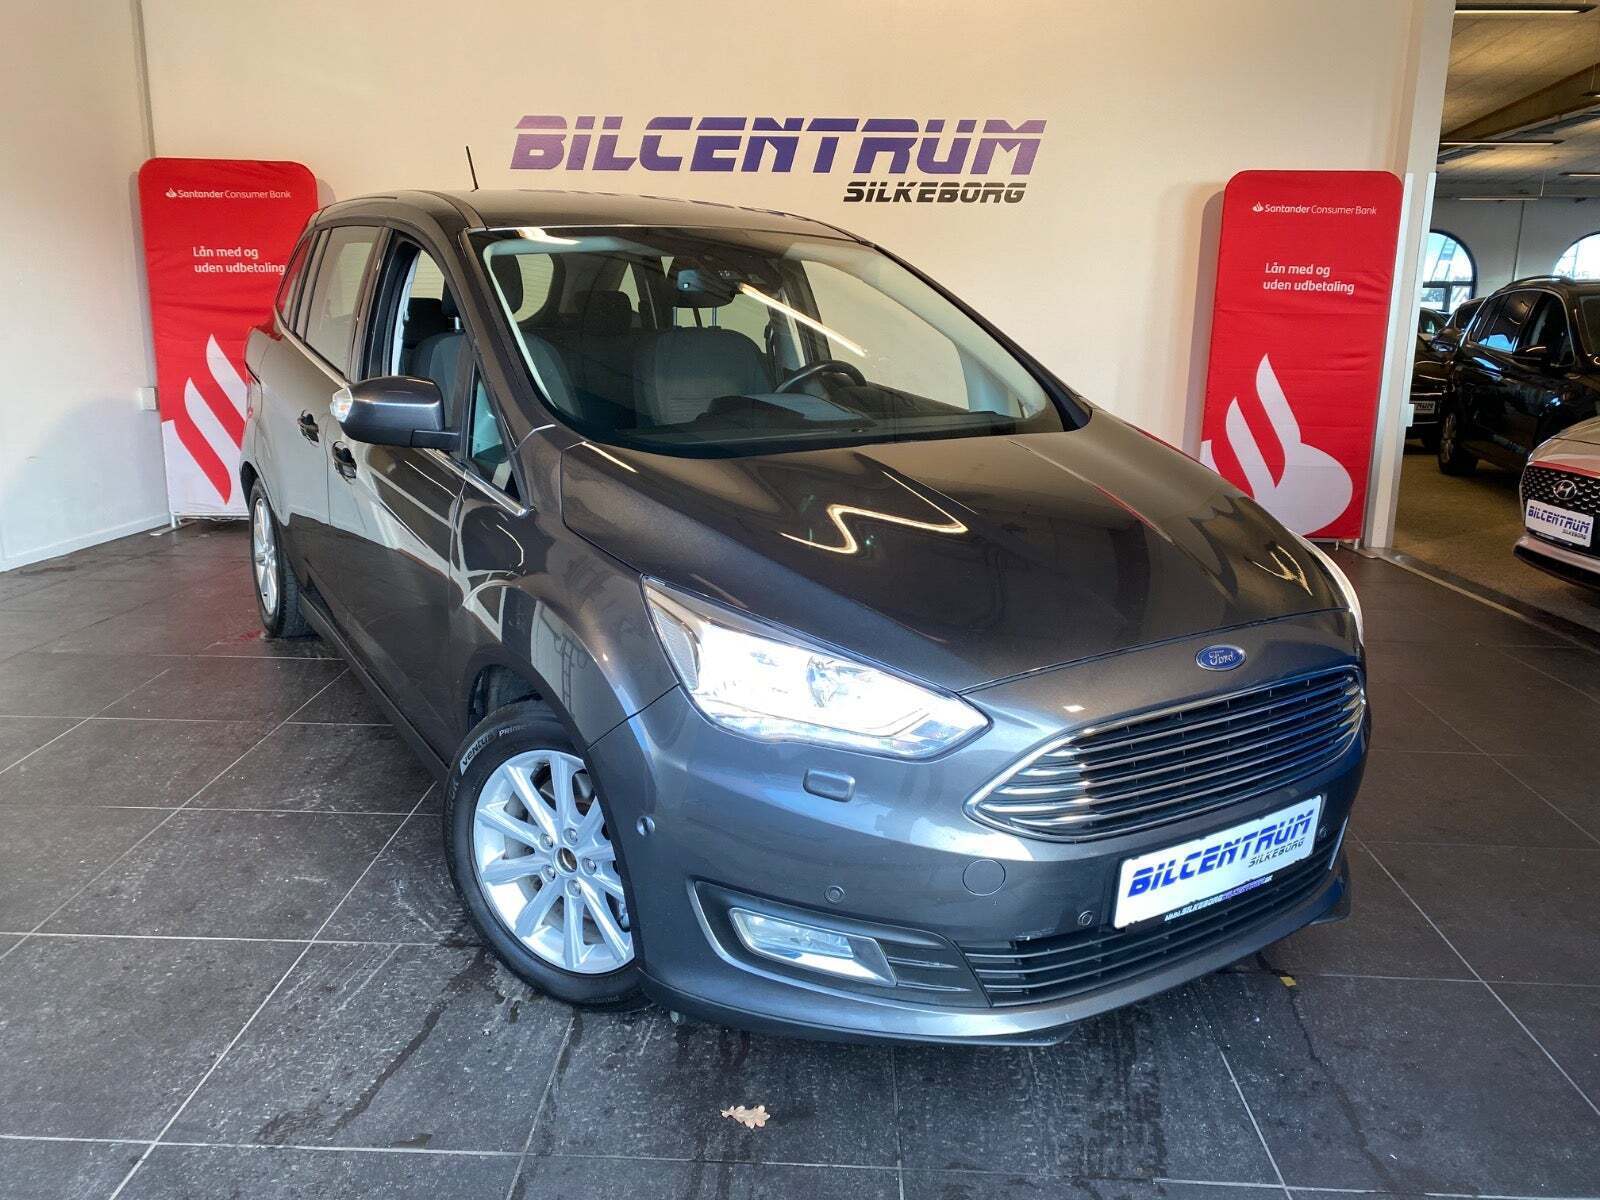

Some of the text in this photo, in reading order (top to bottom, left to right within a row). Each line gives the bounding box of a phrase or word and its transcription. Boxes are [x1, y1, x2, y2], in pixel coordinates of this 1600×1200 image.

[510, 115, 1047, 175] BILCENTRUM
[178, 189, 291, 198] Santander Consumer Bank
[843, 181, 1027, 203] SILKEBORG
[1265, 204, 1377, 215] Santander Consumer Bank
[193, 246, 259, 260] Lån med og
[194, 262, 285, 275] uden udbetaling
[1265, 261, 1330, 278] Lån med og
[1263, 279, 1354, 295] uden udbetaling
[1528, 505, 1591, 534] BILCENTRUM
[1208, 649, 1233, 666] Ford
[1128, 807, 1315, 898] BILCENTRUM
[1248, 837, 1305, 868] SILKEBORG
